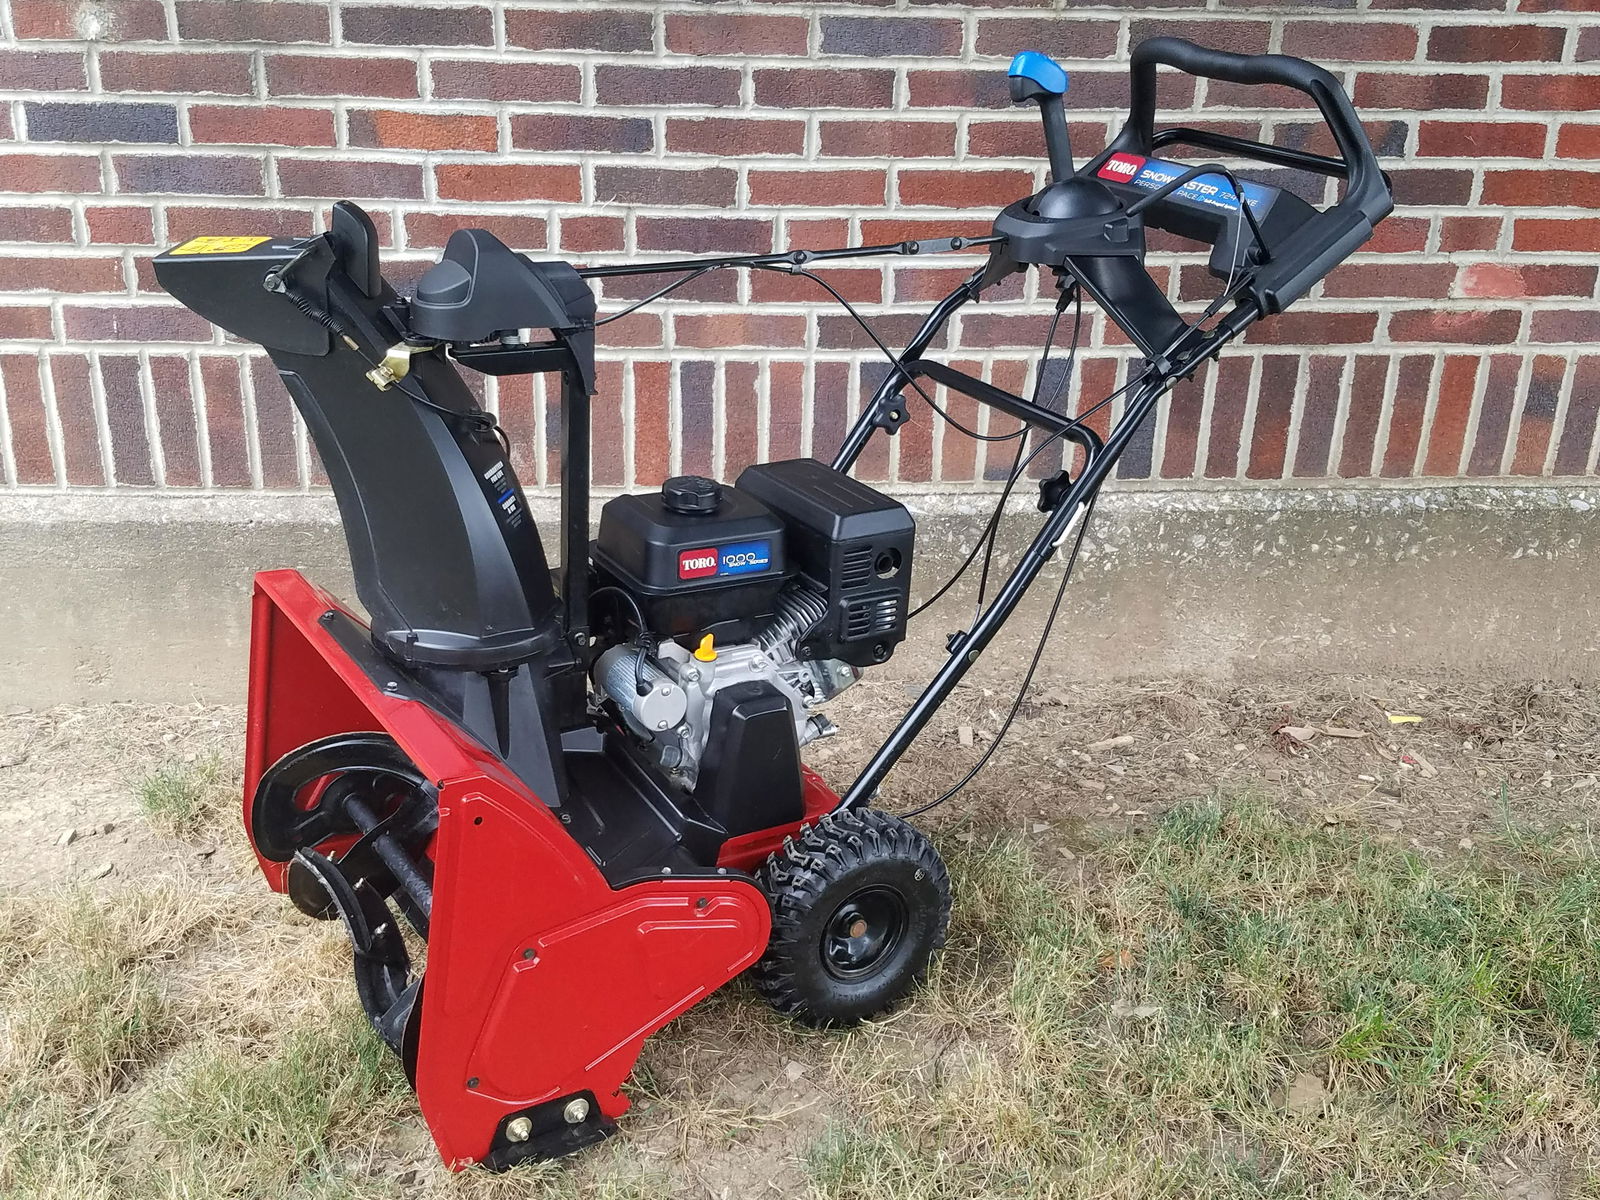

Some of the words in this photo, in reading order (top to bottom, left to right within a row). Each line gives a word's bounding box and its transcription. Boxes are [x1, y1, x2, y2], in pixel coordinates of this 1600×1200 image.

[1140, 169, 1219, 196] SNOWASTER
[1176, 190, 1199, 201] PACE
[723, 552, 756, 564] 1000
